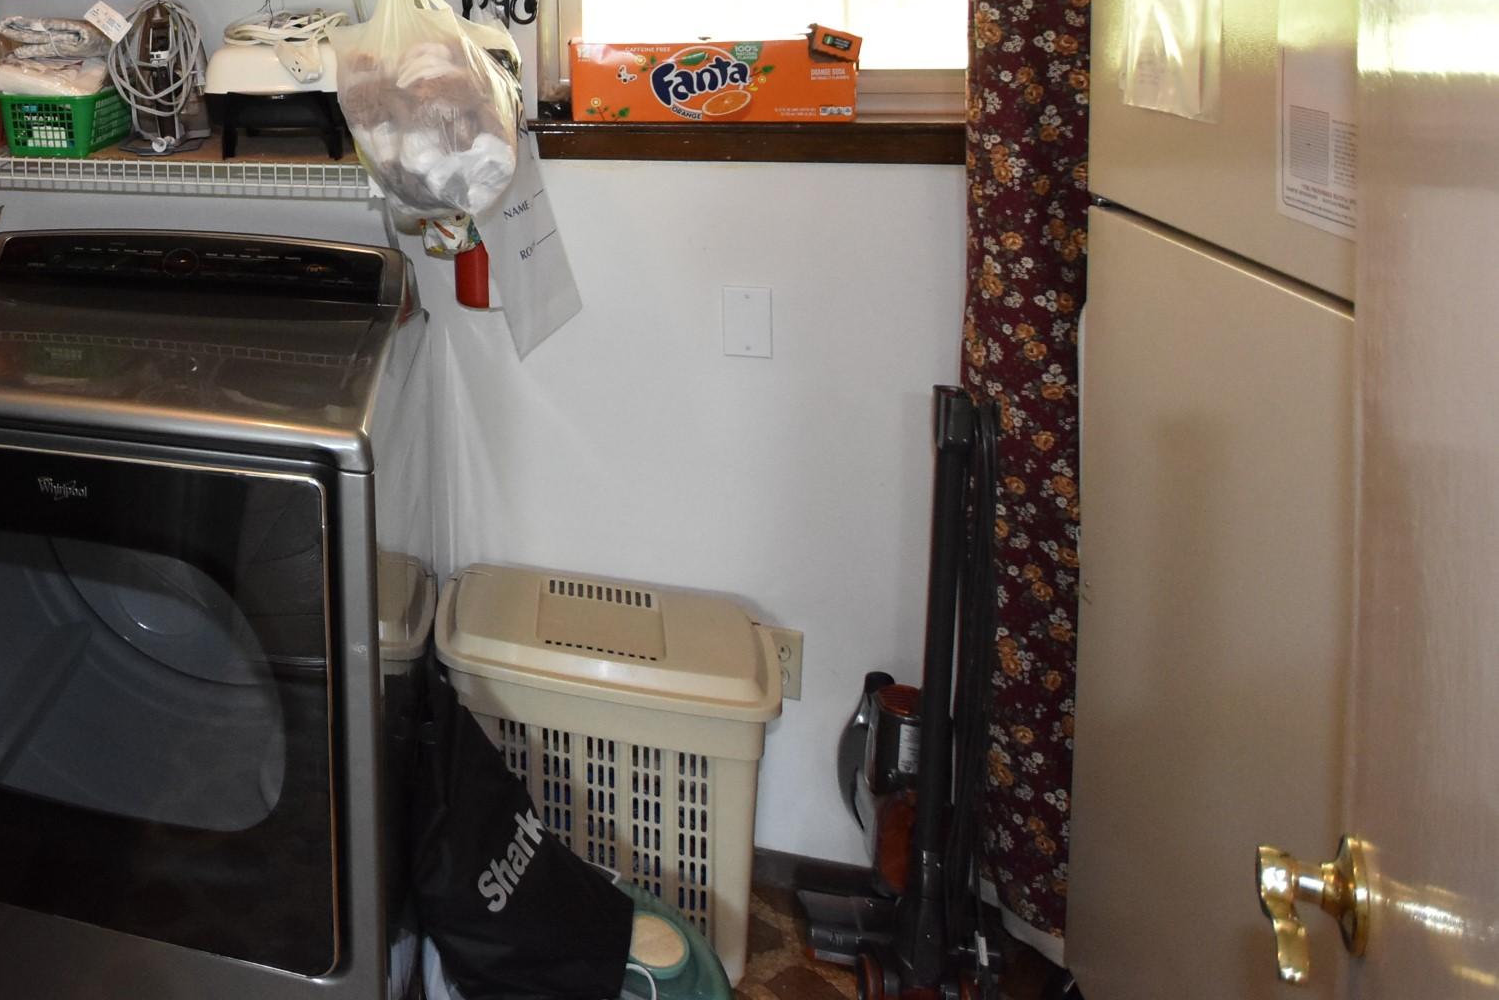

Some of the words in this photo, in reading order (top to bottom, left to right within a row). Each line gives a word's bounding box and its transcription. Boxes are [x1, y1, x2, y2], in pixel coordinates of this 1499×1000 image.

[651, 56, 749, 106] Fanta
[671, 106, 702, 121] ORANGE
[503, 200, 530, 220] NAME
[38, 477, 88, 499] Whirlpool
[478, 808, 545, 912] Shark
